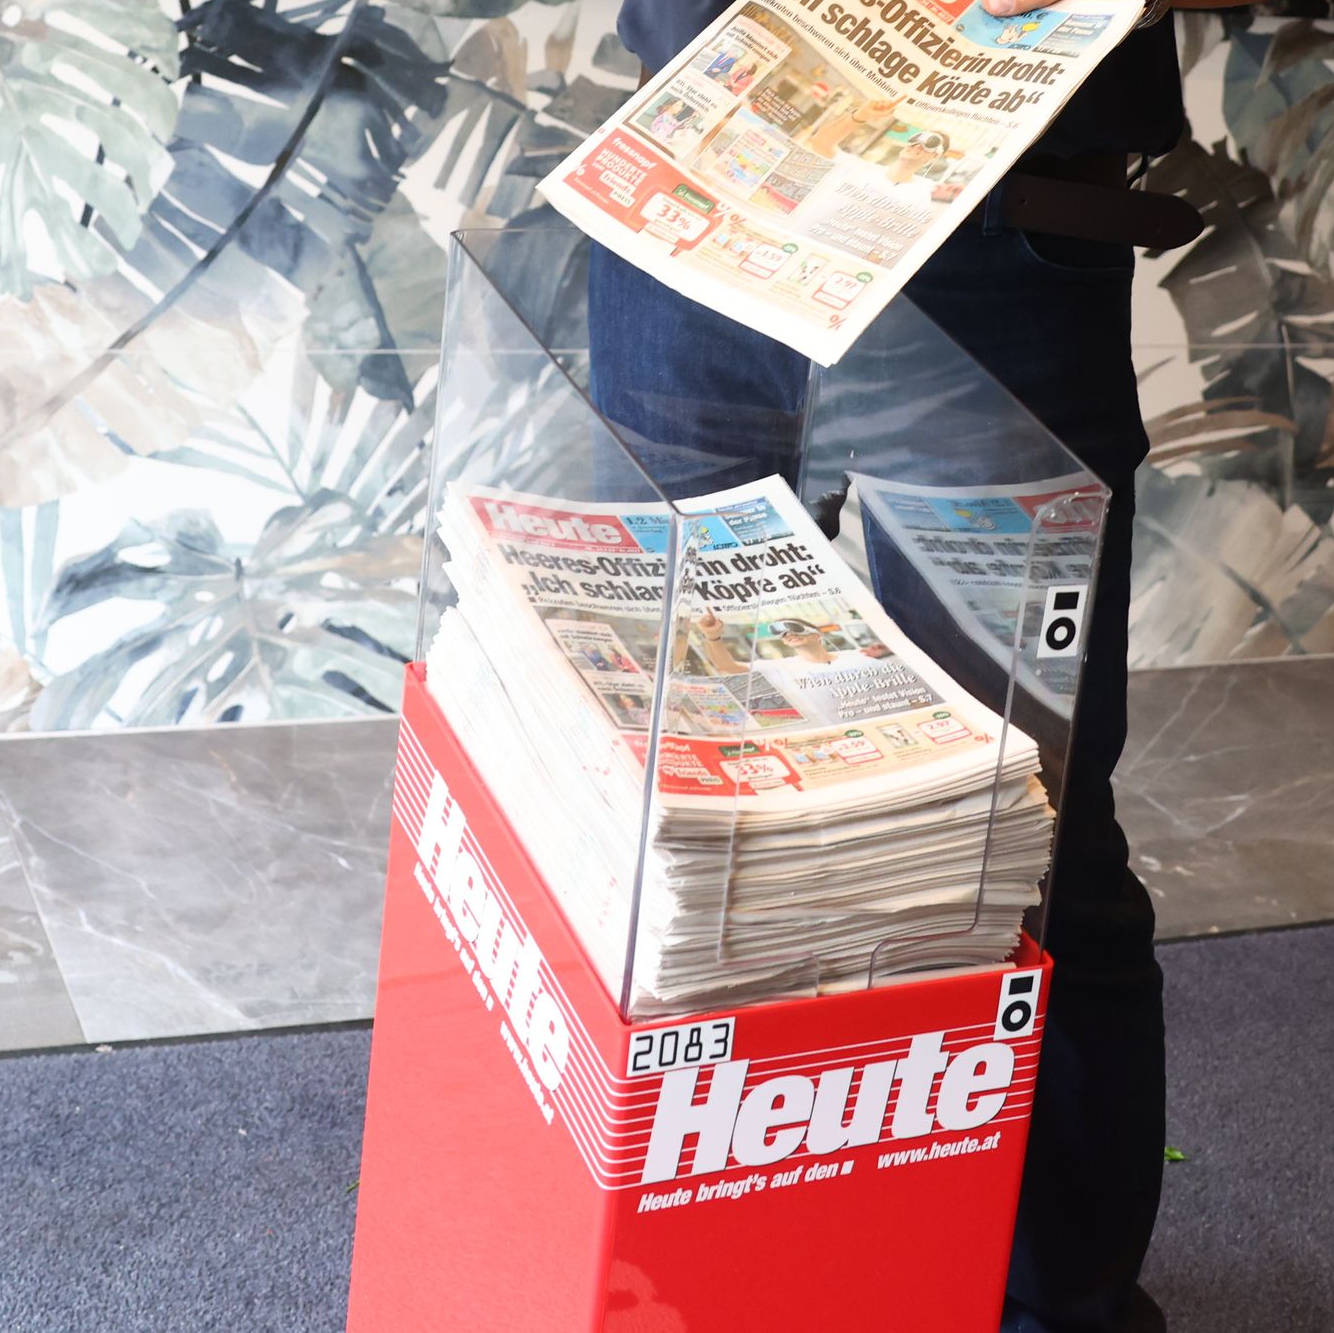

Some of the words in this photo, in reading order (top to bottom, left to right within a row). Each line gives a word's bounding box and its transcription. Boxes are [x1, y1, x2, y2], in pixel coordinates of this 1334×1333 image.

[794, 11, 835, 49] beschweren
[835, 44, 850, 62] sich
[849, 52, 867, 75] über
[867, 67, 898, 97] Mobbing
[821, 2, 921, 86] schlage
[916, 70, 991, 107] Köpfe
[988, 56, 1065, 86] droht:
[483, 502, 622, 544] Heute
[730, 543, 814, 573] droht:
[694, 576, 777, 603] Köpfe
[795, 676, 832, 690] Wien
[836, 665, 879, 685] durch
[881, 663, 906, 676] die
[830, 673, 917, 699] Apple-Brille
[899, 687, 926, 698] Vision
[418, 769, 569, 1092] Heute
[632, 1023, 730, 1072] 2083
[640, 1031, 1015, 1185] Heute
[637, 1190, 691, 1214] Heute
[695, 1175, 766, 1210] bringt's
[770, 1165, 804, 1189] auf
[805, 1161, 838, 1181] den
[877, 1132, 1002, 1170] www.heute.at
